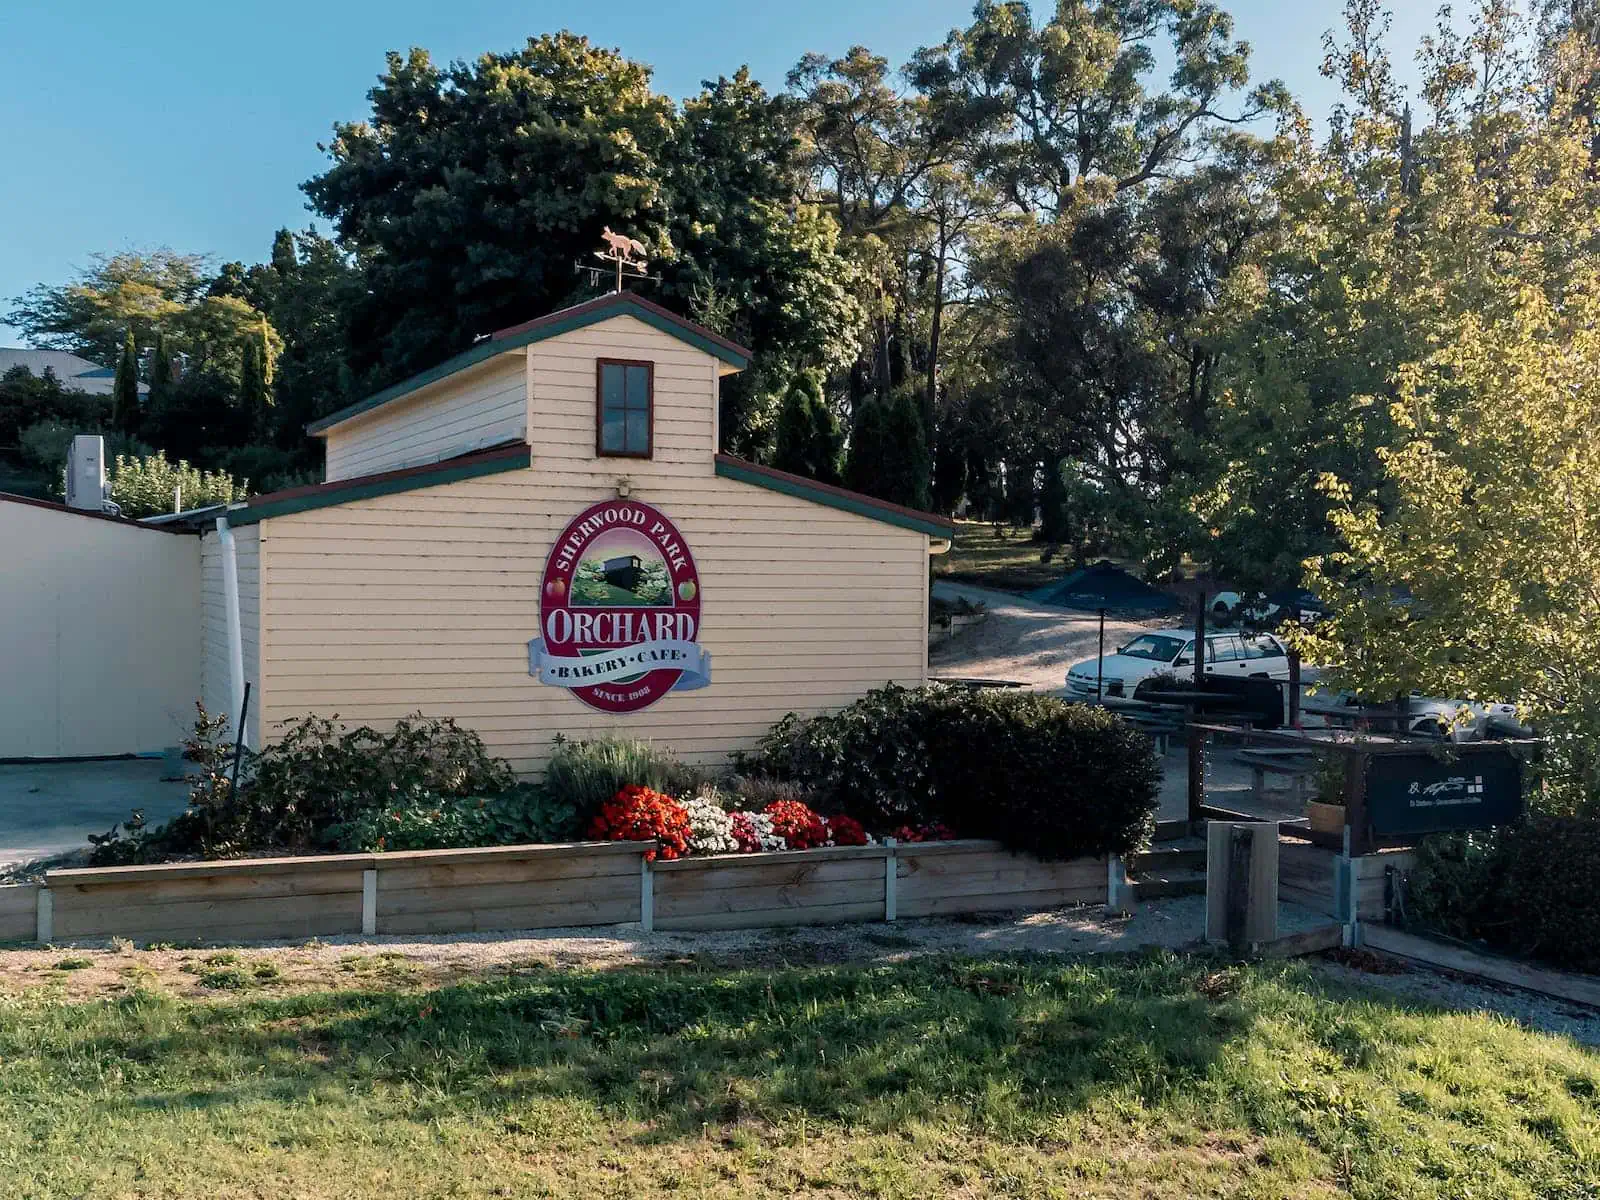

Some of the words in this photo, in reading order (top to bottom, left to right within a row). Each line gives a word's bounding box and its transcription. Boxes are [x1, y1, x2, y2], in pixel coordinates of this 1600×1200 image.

[556, 508, 645, 572] SHERWOOD
[650, 521, 687, 572] PARK
[547, 608, 695, 645] ORCHARD
[558, 657, 629, 678] BAKERY
[637, 649, 681, 663] CAFE
[592, 687, 625, 702] SINCE
